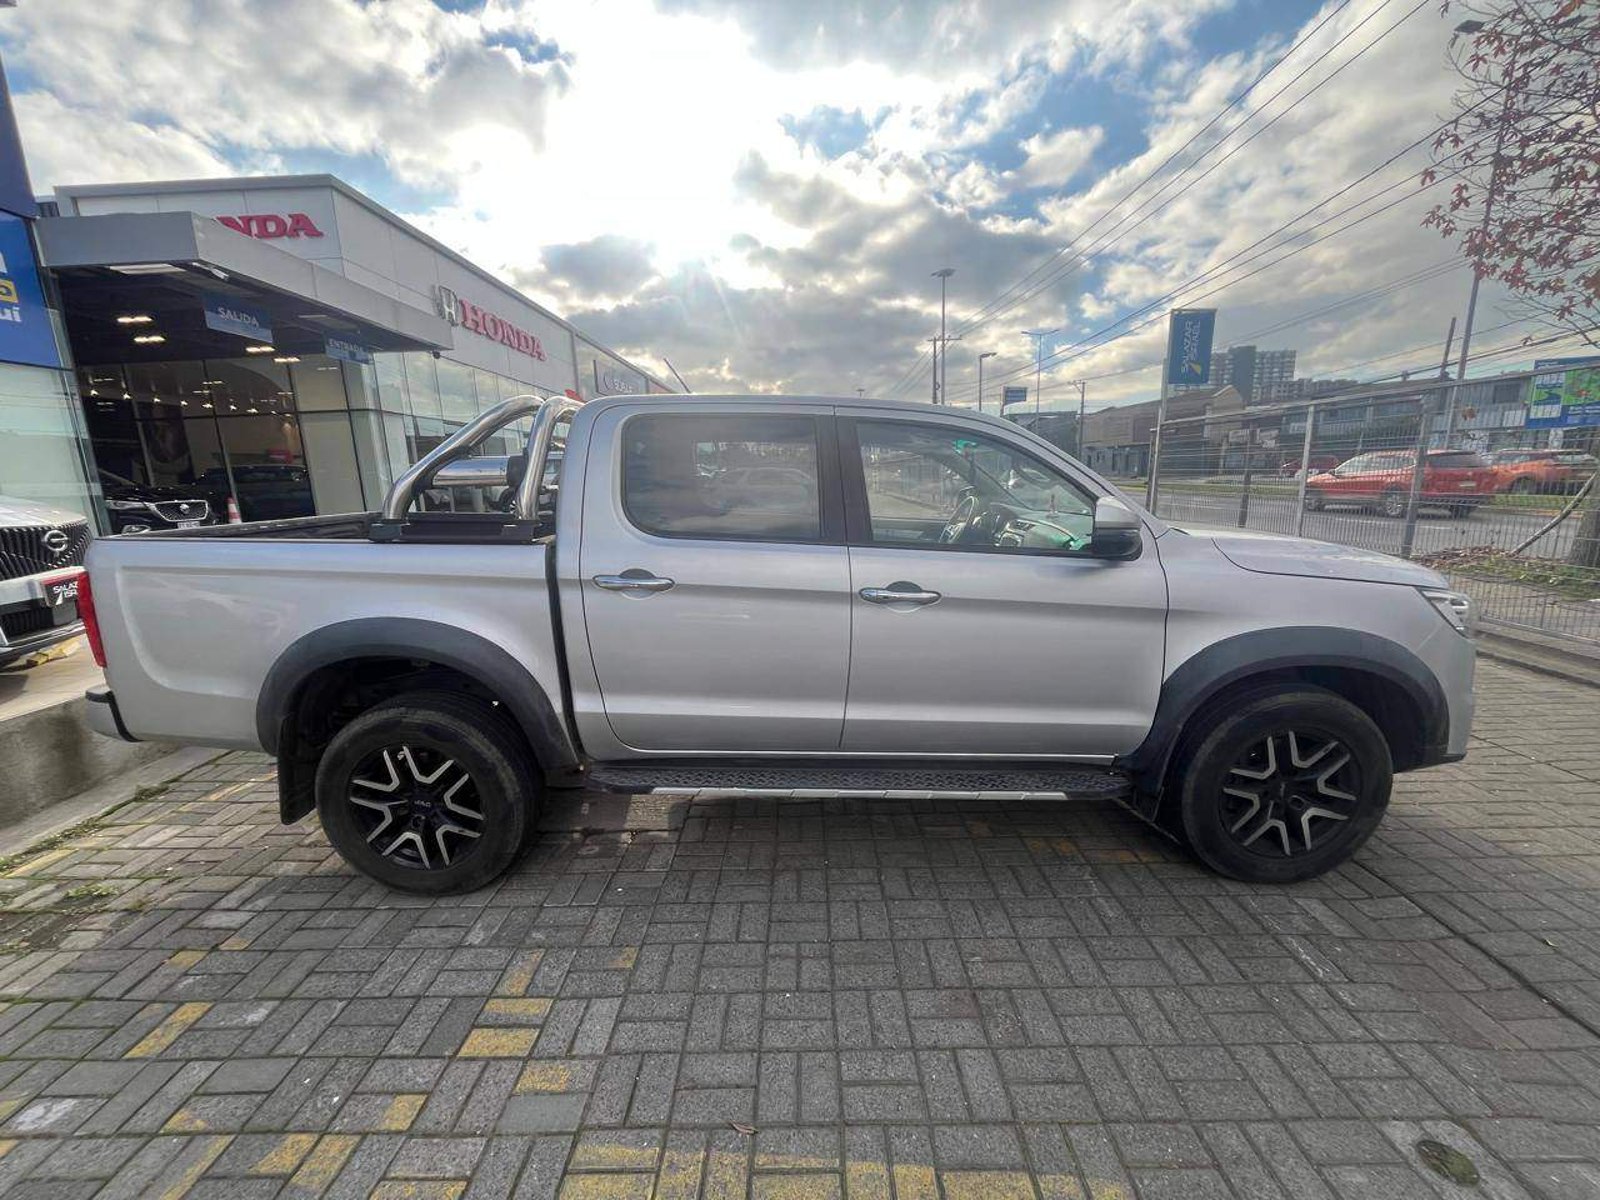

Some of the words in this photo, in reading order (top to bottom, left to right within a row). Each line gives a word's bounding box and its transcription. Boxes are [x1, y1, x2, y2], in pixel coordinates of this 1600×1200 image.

[214, 213, 324, 238] NDA
[217, 306, 260, 329] SALIDA
[459, 299, 546, 361] HONDA
[53, 581, 79, 594] SALAZ
